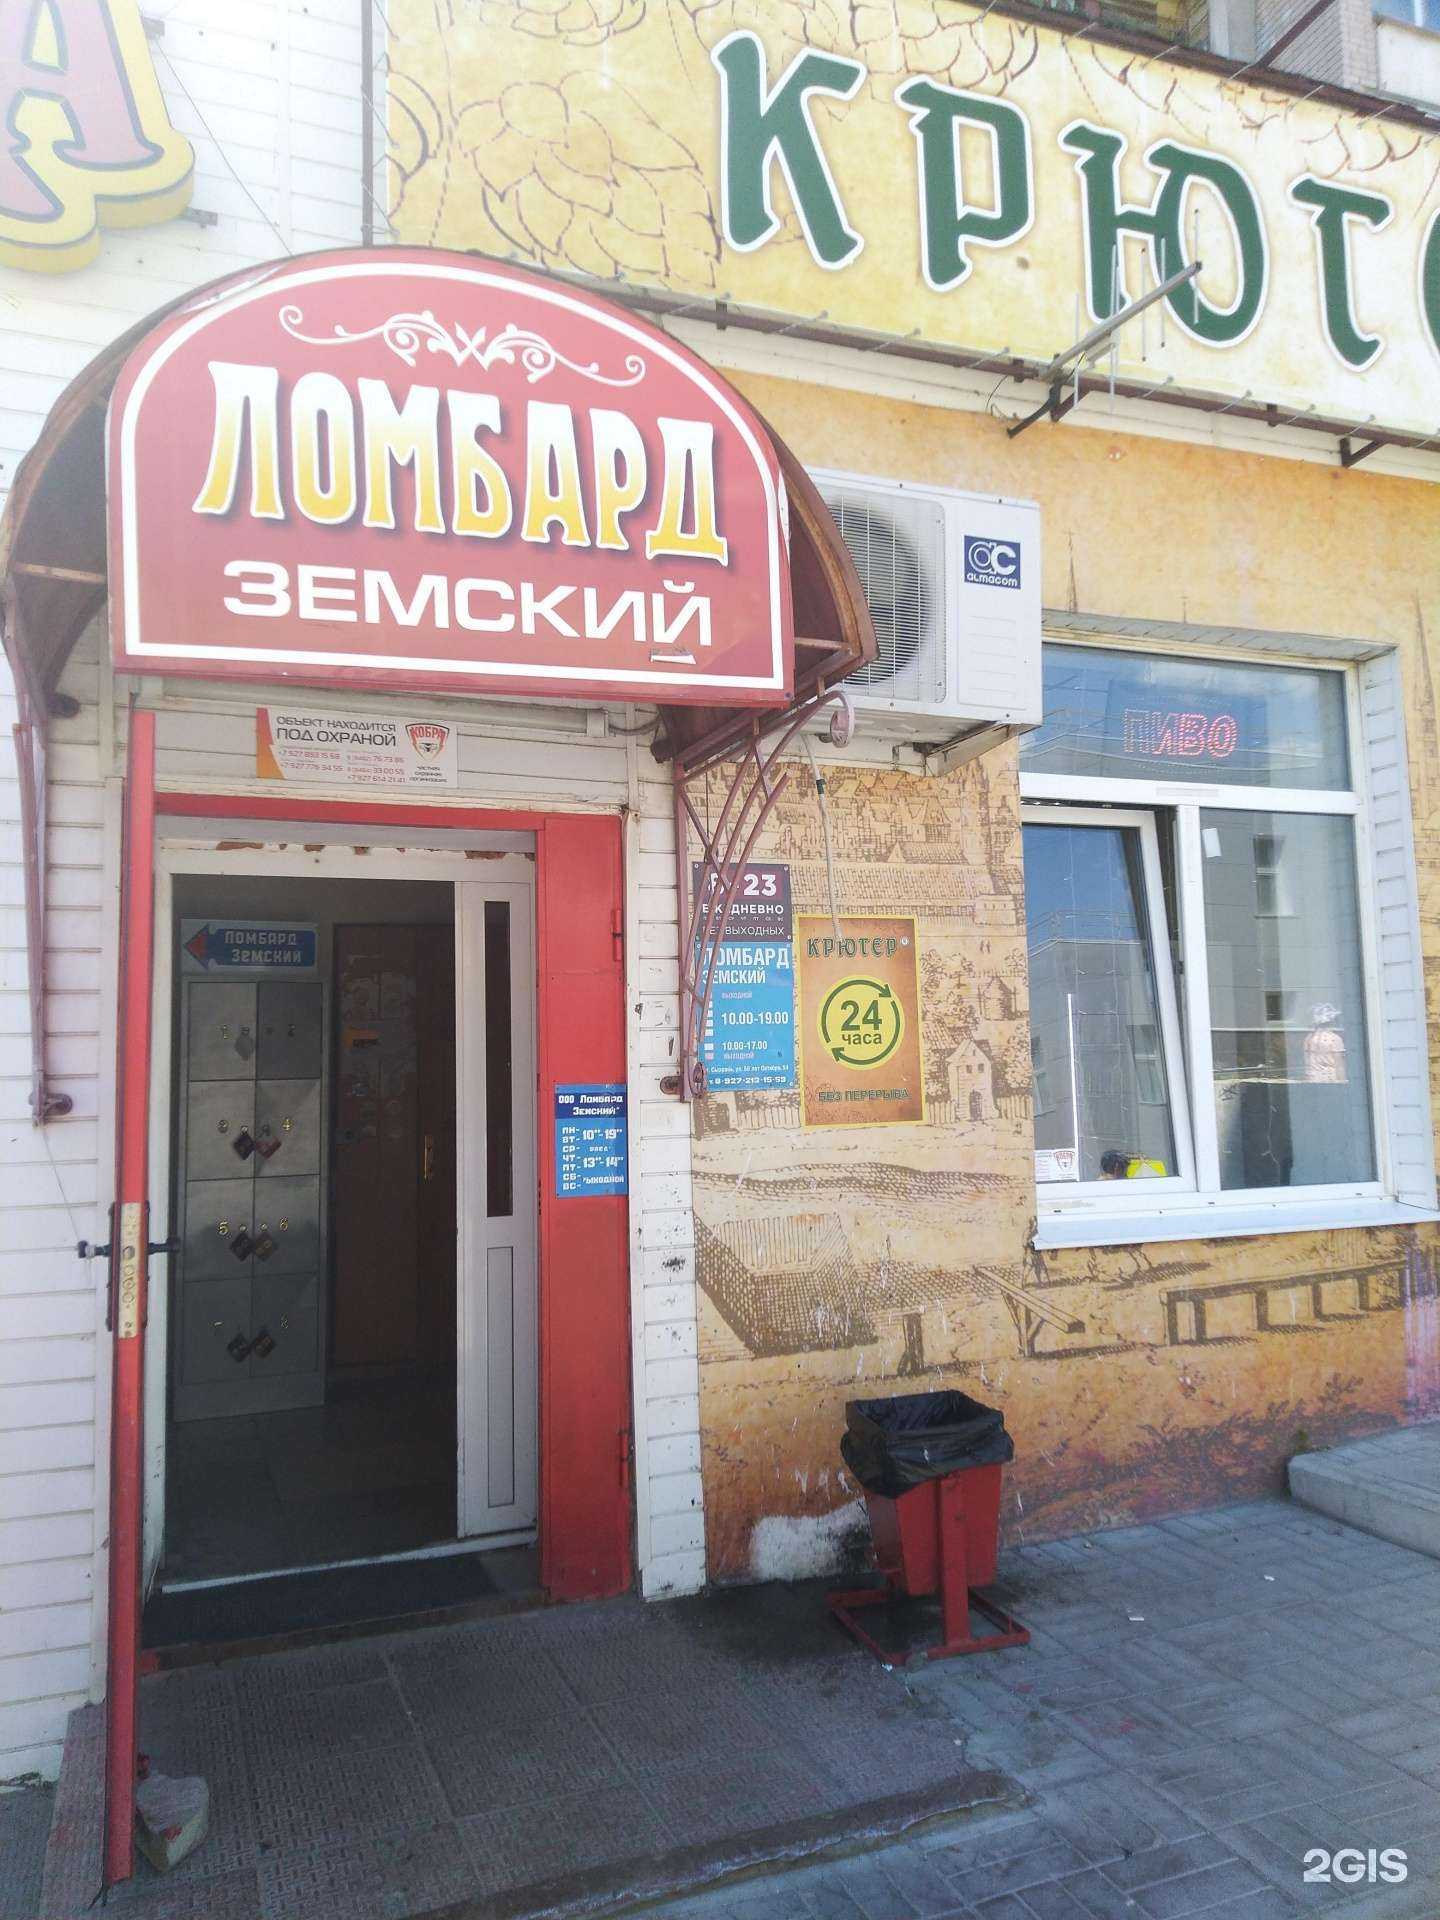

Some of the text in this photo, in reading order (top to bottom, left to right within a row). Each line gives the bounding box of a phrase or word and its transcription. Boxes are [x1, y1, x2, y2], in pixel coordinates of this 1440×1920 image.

[710, 28, 1440, 372] КРЮТ
[192, 361, 729, 567] ЛОМБАРД
[223, 560, 711, 646] ЗЕМСКИЙ
[276, 716, 397, 733] ОБЪЕКТ НАХОДИТСЯ
[1123, 708, 1237, 758] ПИВО
[276, 728, 397, 747] ПОД ОХРАНОЙ
[743, 873, 777, 897] 23
[224, 930, 297, 946] ЛОМБАРД
[725, 927, 784, 937] ВЫХОДНЫХ
[807, 937, 897, 958] КРЮТЕР
[721, 1012, 789, 1025] 10.00-19.00
[841, 1000, 882, 1031] 24
[842, 1032, 882, 1045] часа
[819, 1088, 909, 1101] БЕЗ ПЕРЕРЫВА
